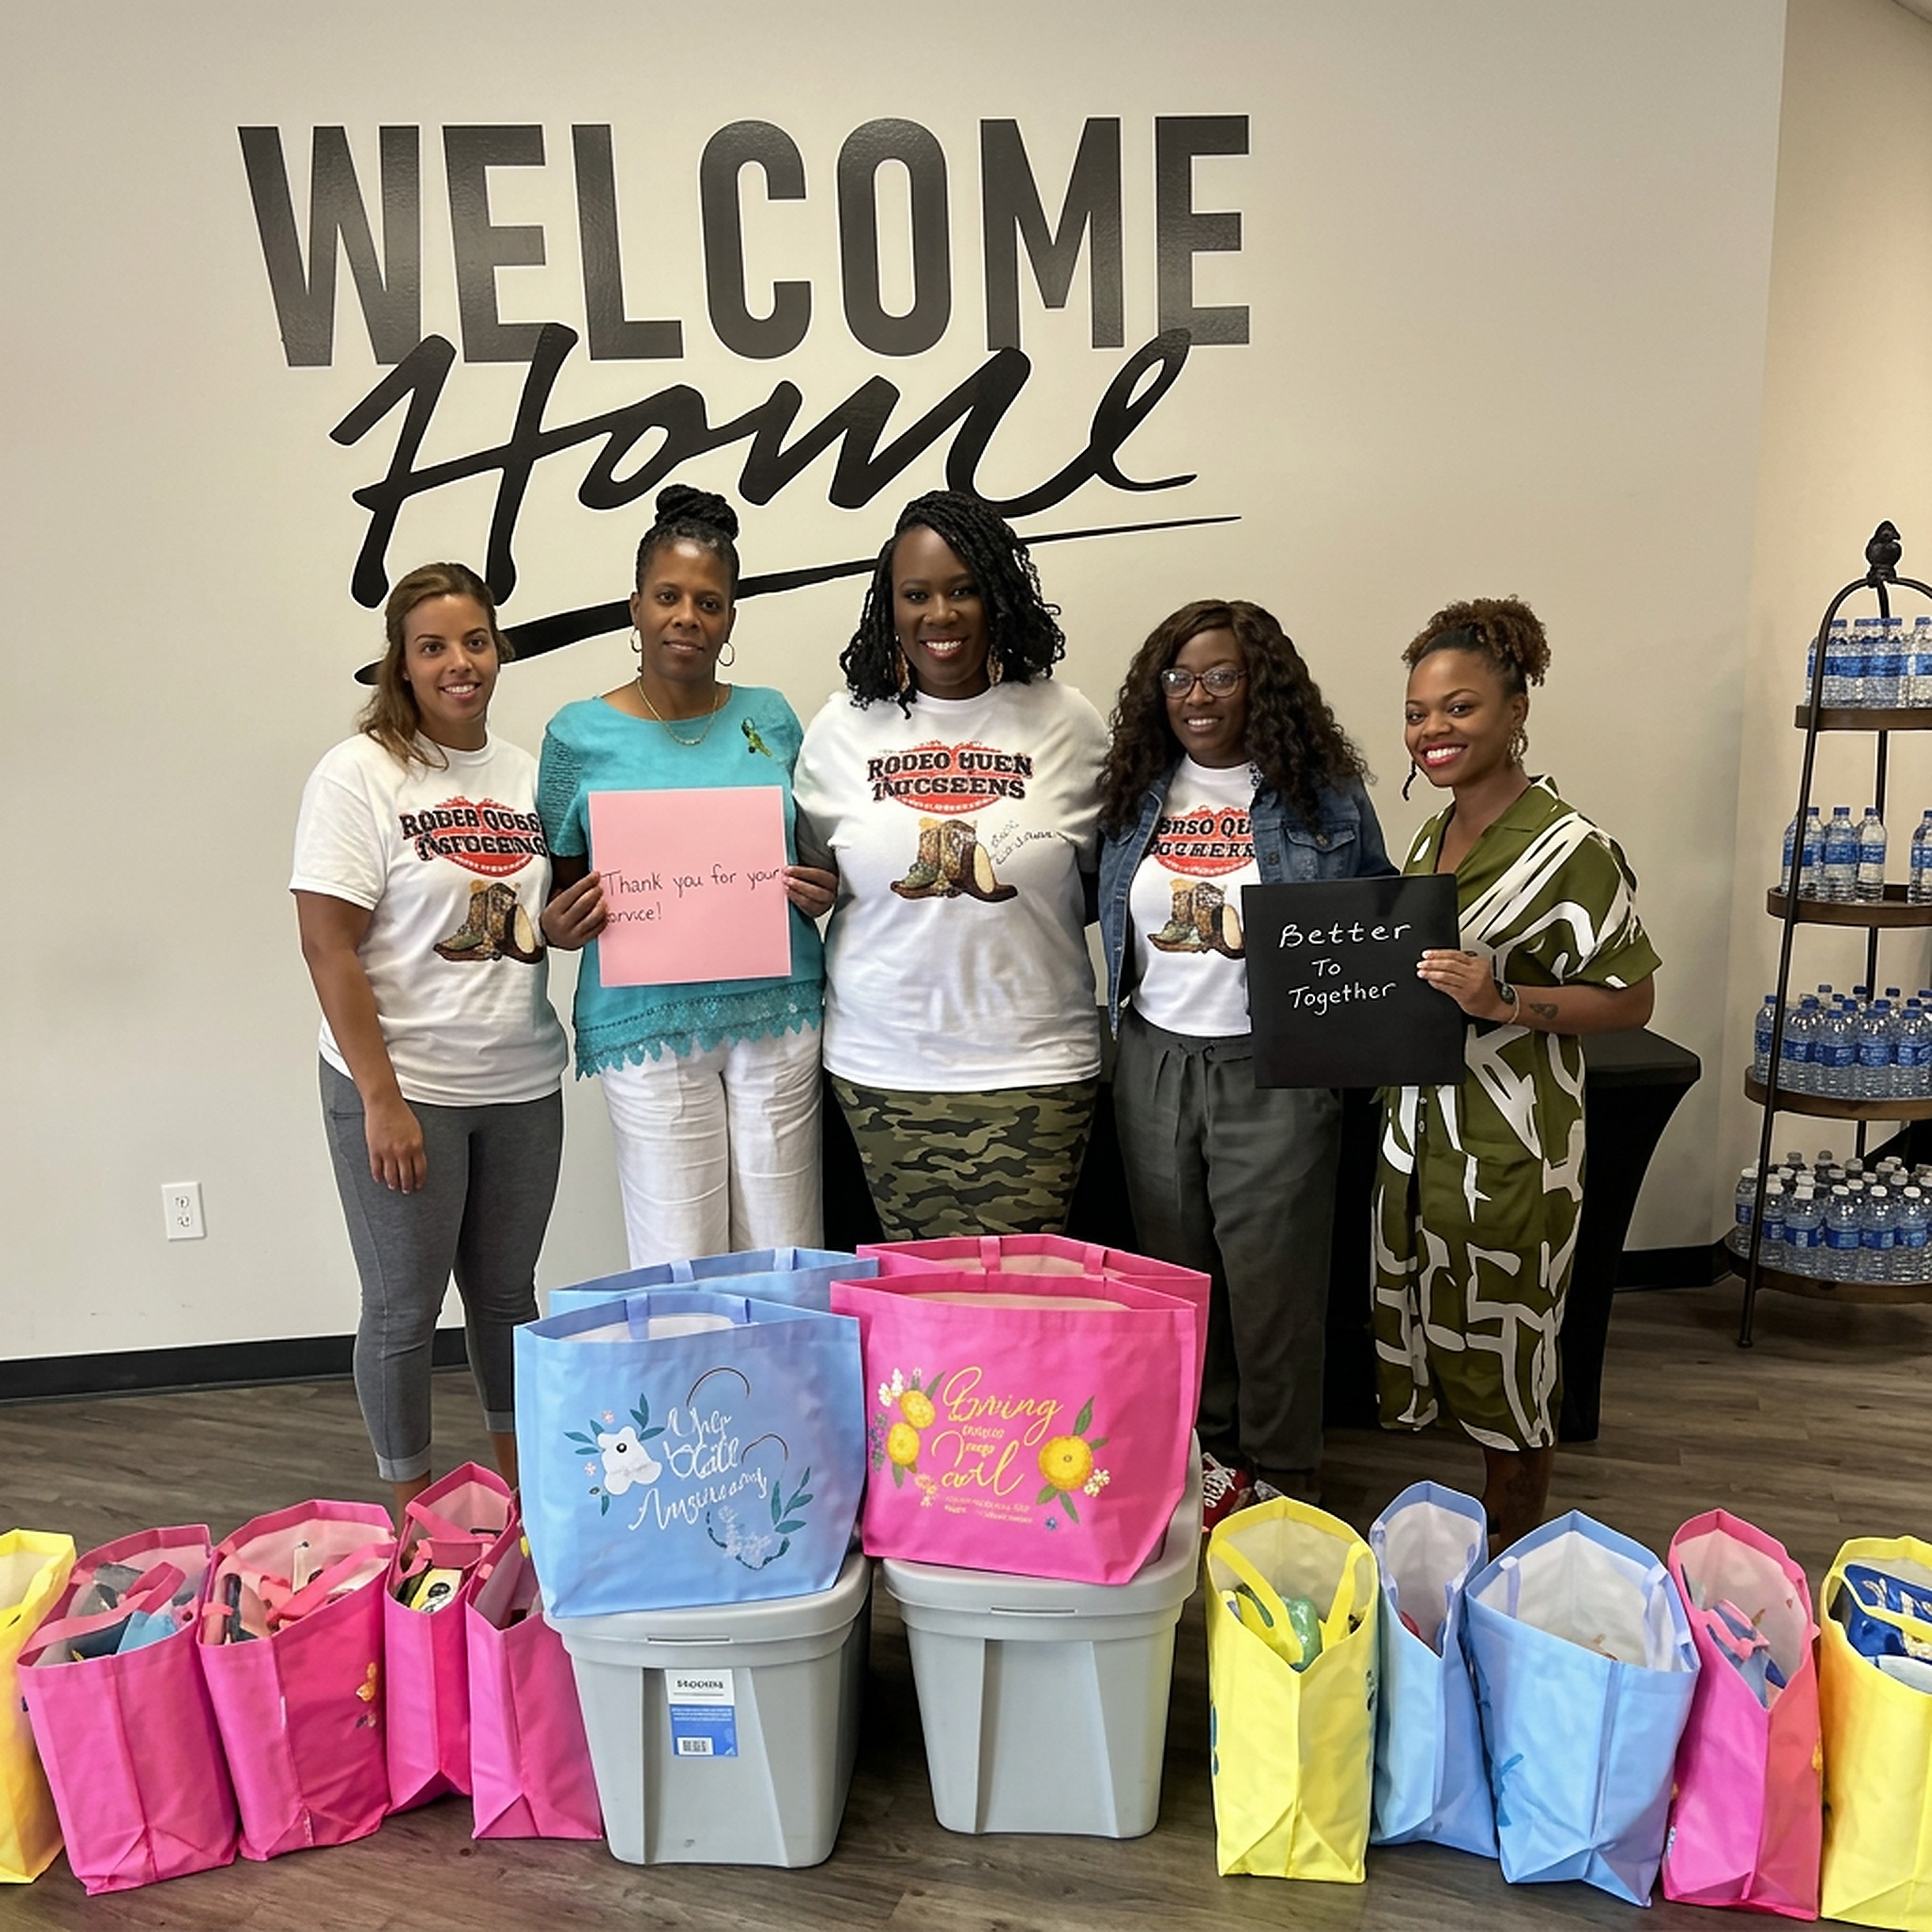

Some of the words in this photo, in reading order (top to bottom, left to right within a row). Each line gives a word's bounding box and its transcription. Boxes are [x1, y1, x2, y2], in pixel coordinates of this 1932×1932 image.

[237, 114, 1250, 367] WELCOME
[329, 322, 1198, 607] Home
[601, 870, 663, 896] Thank
[673, 875, 703, 899] you
[710, 863, 737, 884] for
[747, 868, 780, 891] your
[1278, 922, 1411, 948] Better
[1311, 958, 1341, 977] To
[1287, 982, 1396, 1016] Together
